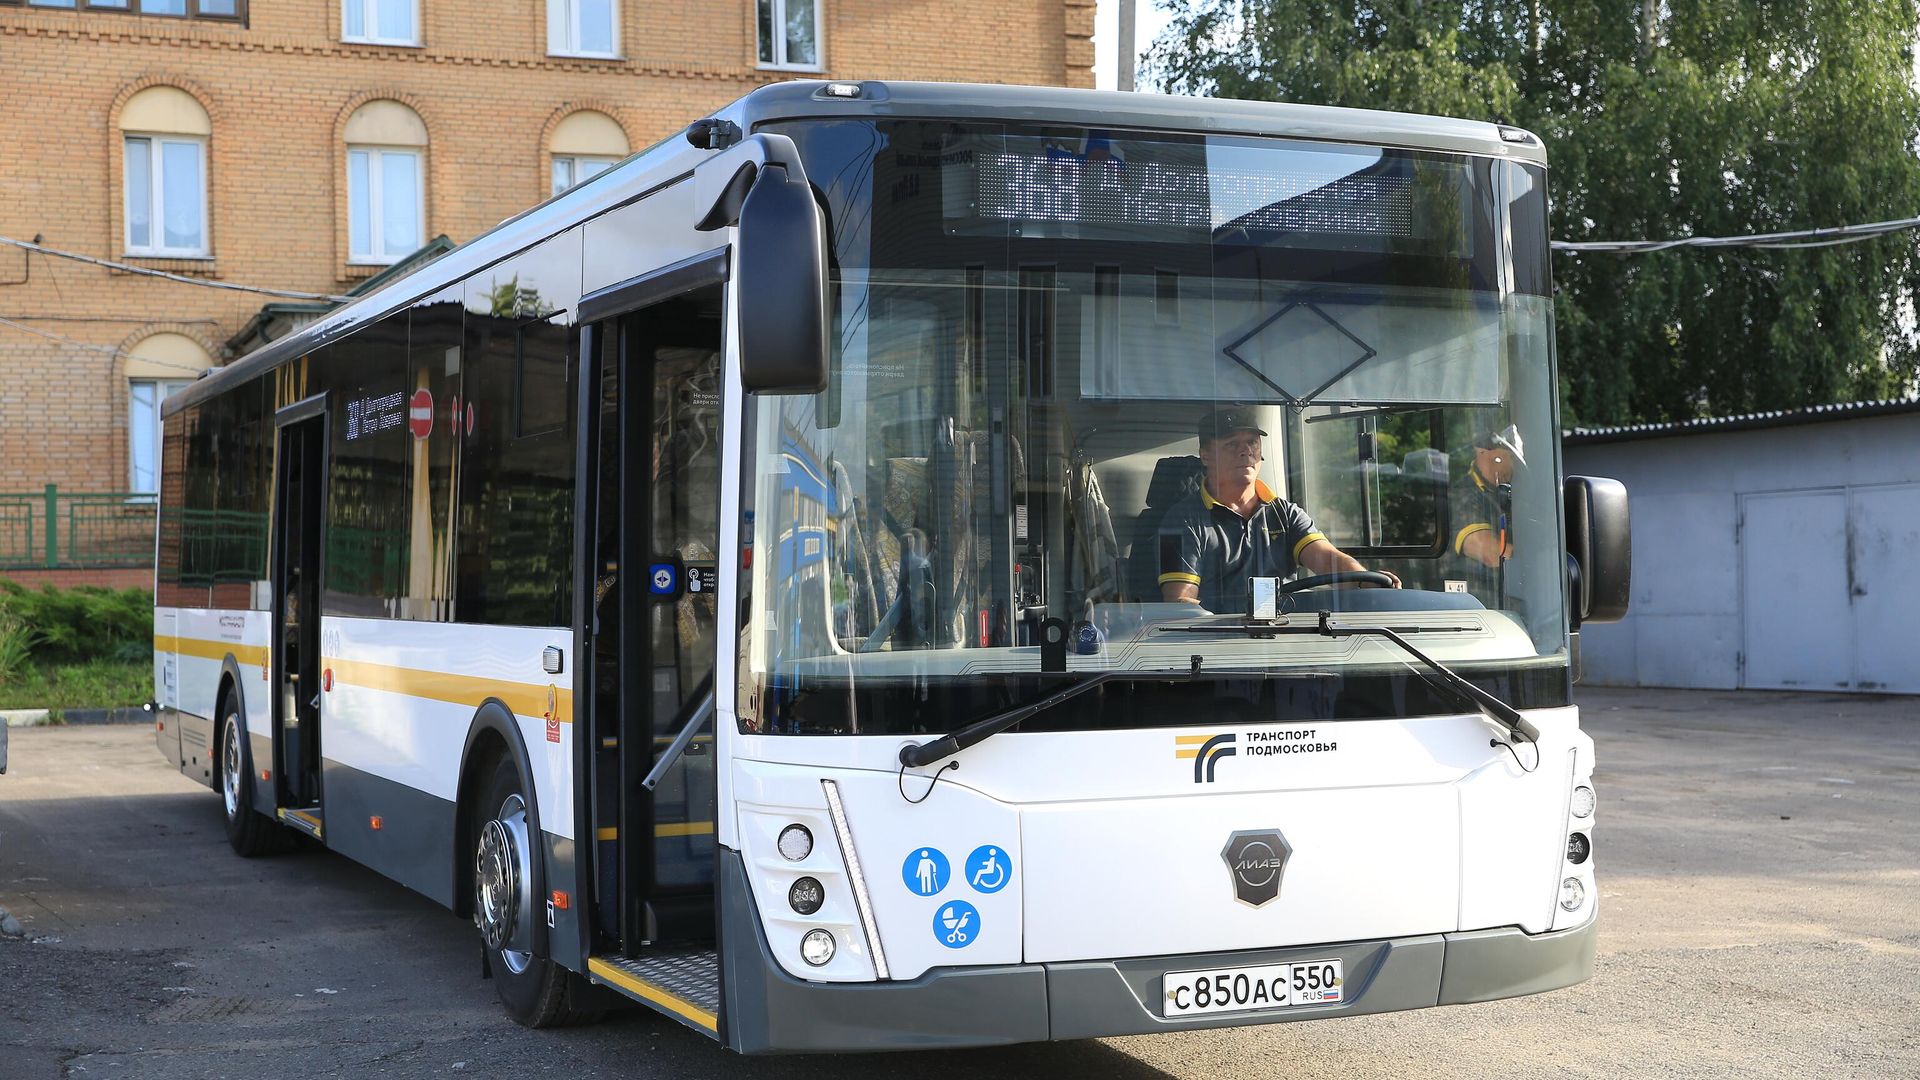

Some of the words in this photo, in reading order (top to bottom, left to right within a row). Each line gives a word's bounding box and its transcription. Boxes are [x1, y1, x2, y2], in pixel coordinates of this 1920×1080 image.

[997, 154, 1080, 221] 368
[1124, 192, 1224, 227] Метро
[1245, 199, 1381, 232] Ховрино
[1246, 729, 1317, 742] ТРАНСПОРТ
[1246, 742, 1338, 756] ПОДМОСКОВЬЯ
[1235, 857, 1282, 870] ЛИАЗ
[1292, 963, 1335, 991] 550
[1302, 991, 1323, 1001] RUS
